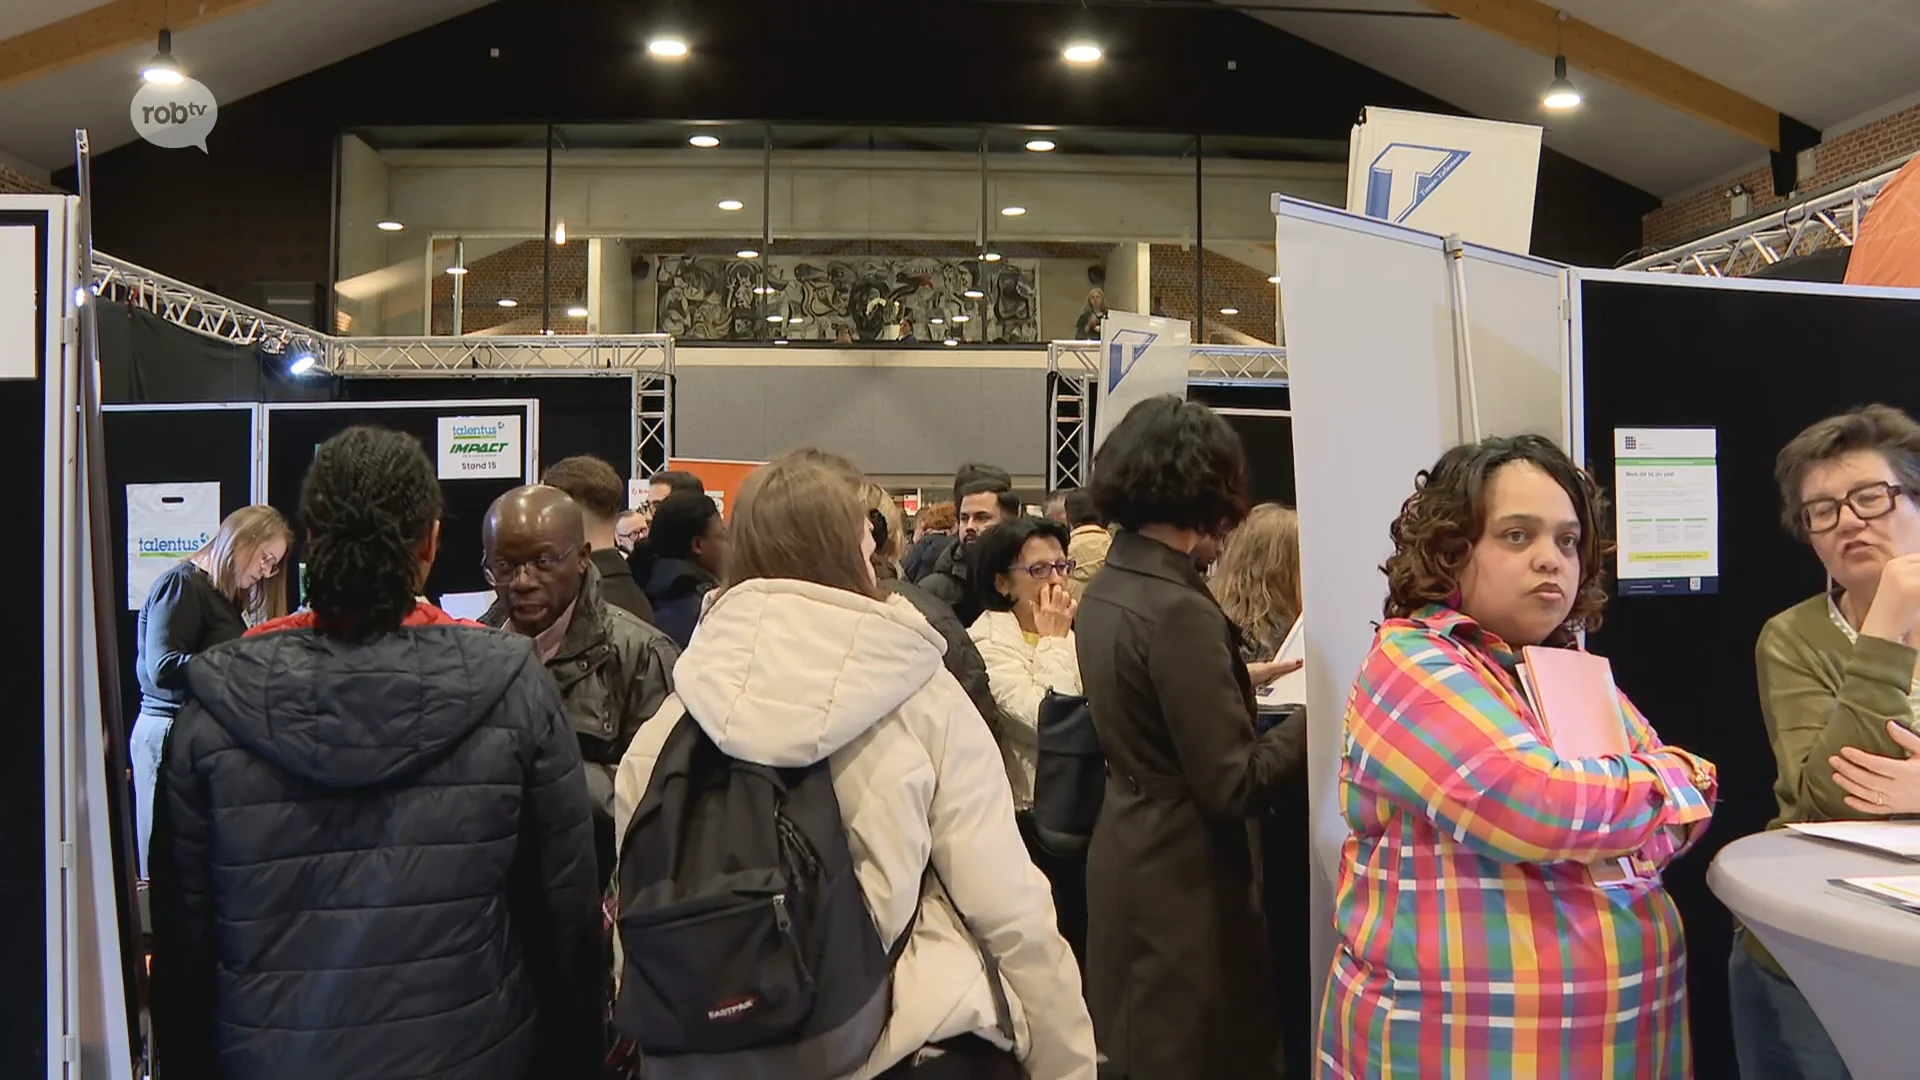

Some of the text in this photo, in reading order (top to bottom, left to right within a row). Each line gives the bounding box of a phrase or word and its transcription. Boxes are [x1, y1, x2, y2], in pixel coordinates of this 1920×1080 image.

[452, 425, 497, 436] talentus
[449, 442, 508, 454] IMPACT
[462, 461, 497, 470] Stand 15
[138, 536, 199, 552] talentus
[707, 998, 755, 1020] EASTPAK
